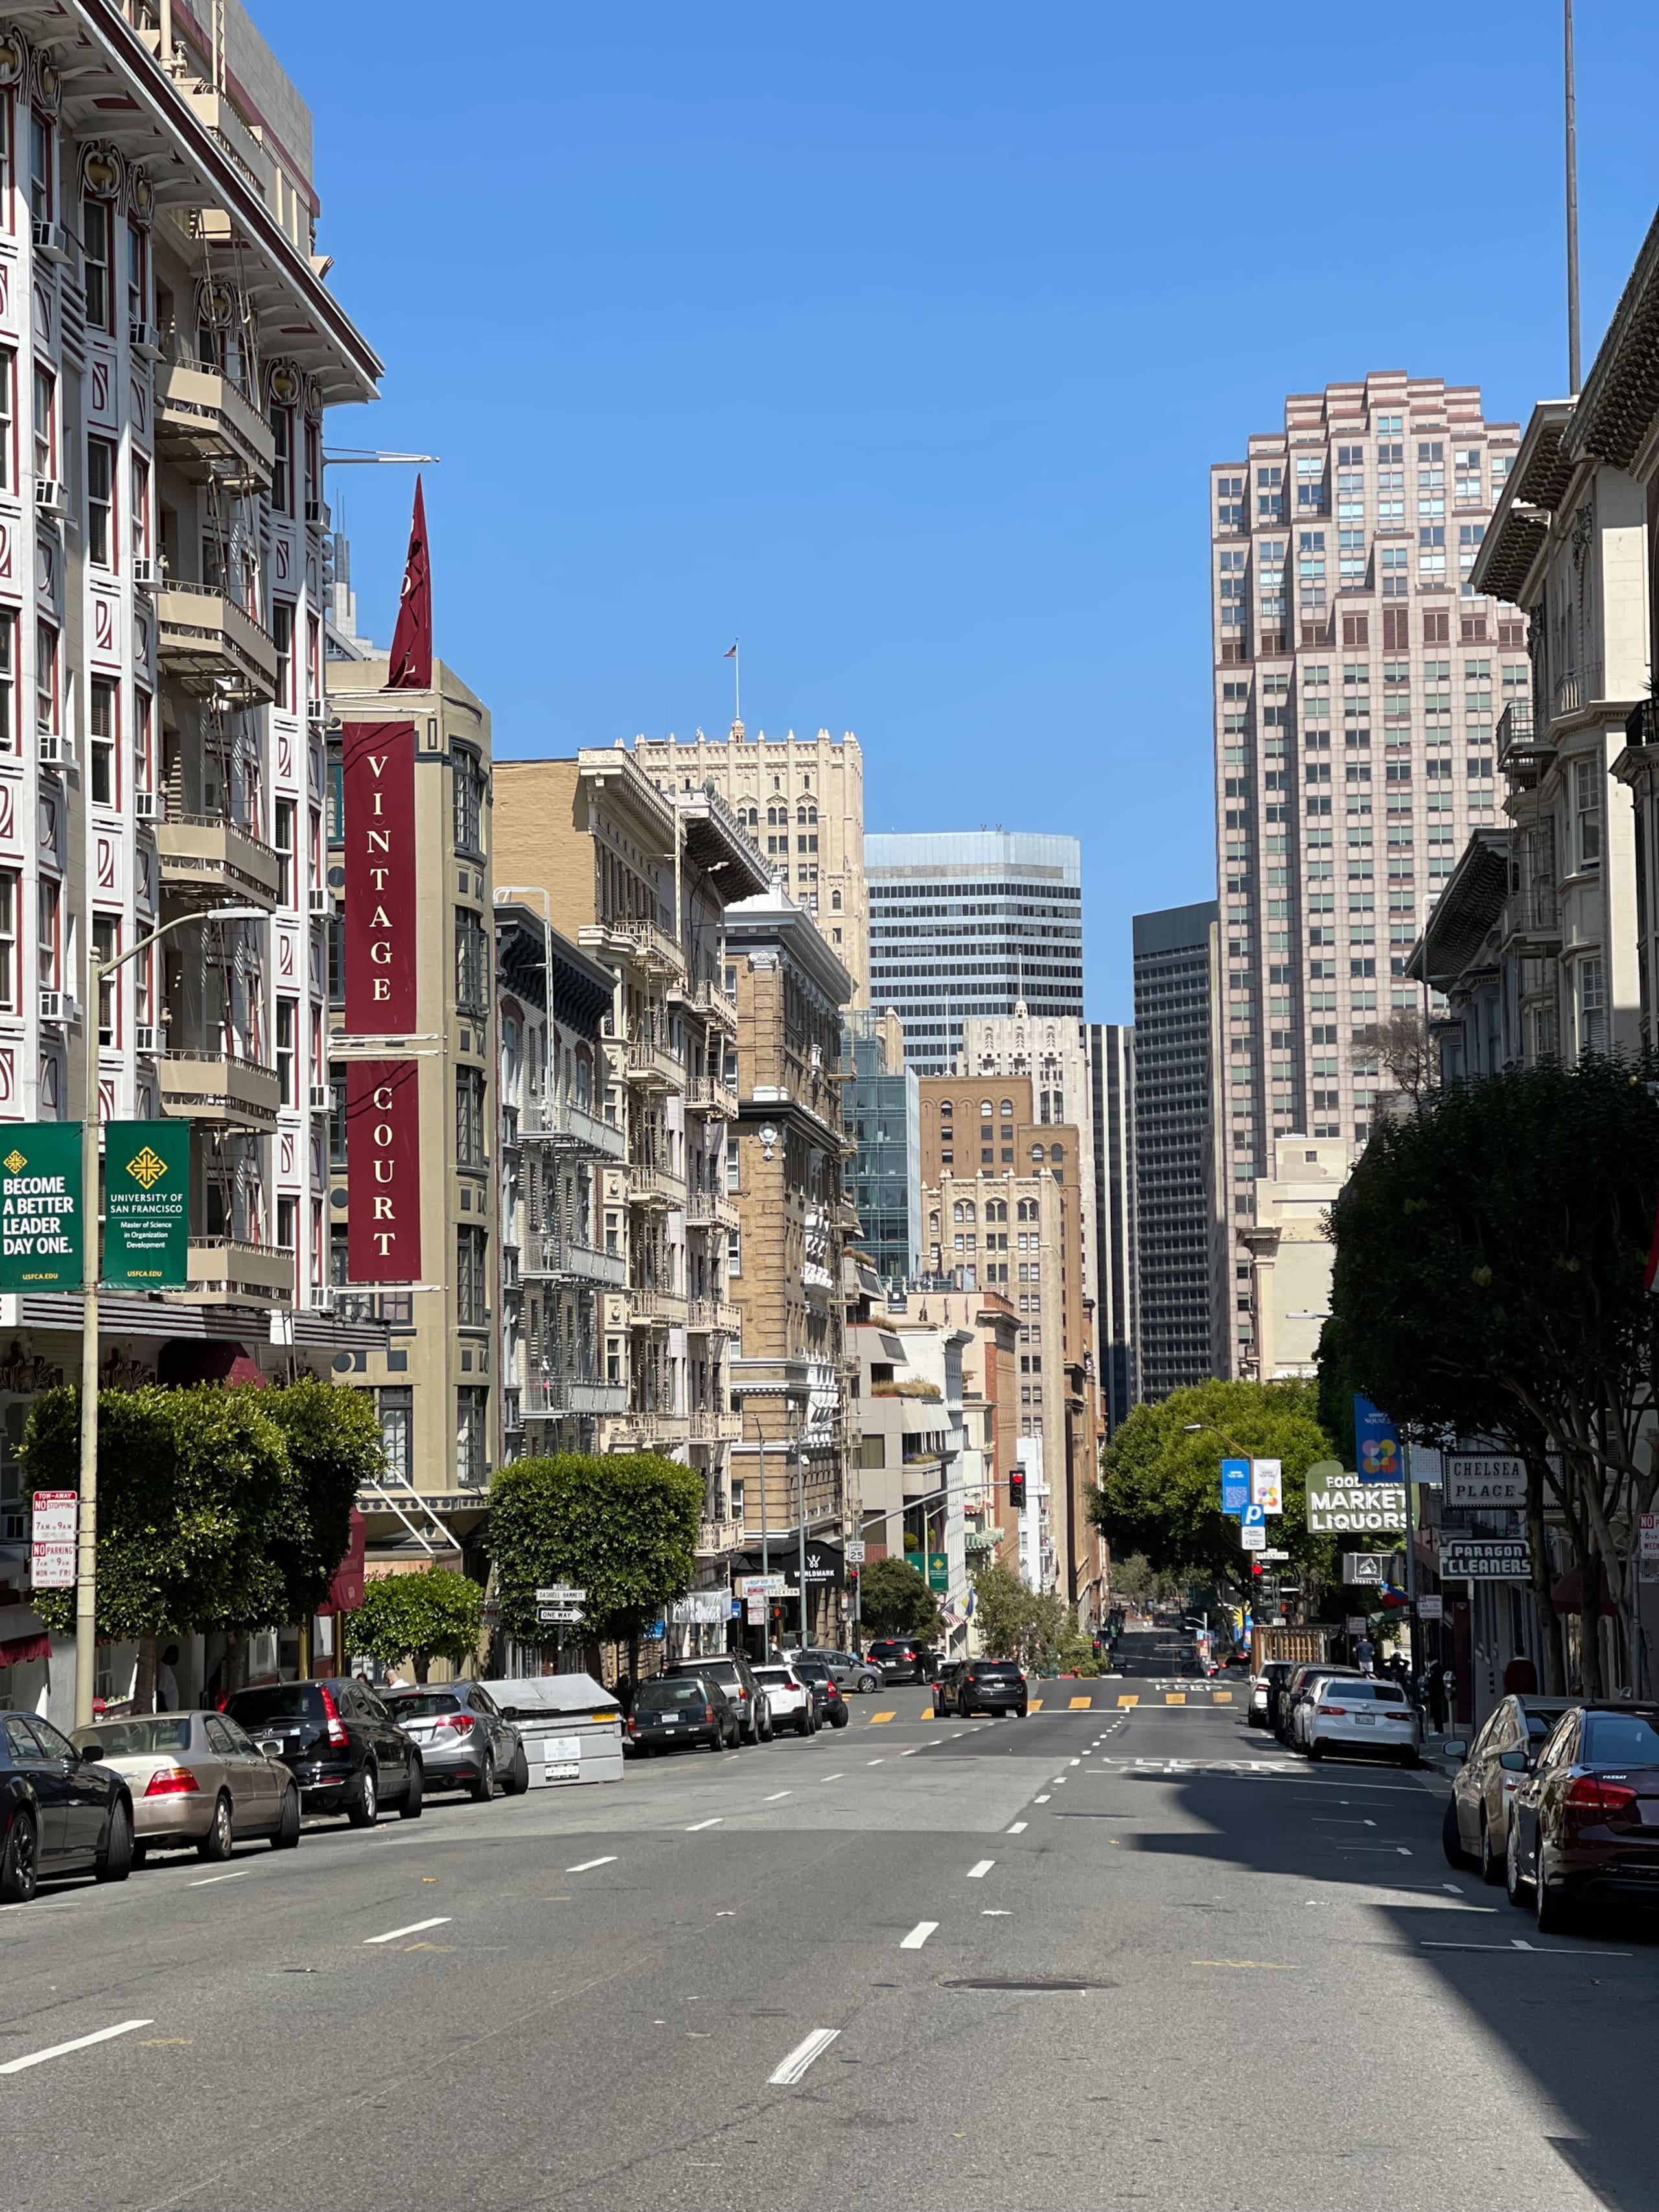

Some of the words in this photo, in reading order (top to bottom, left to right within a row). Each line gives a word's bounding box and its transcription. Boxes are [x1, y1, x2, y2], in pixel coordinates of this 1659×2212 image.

[366, 756, 392, 1001] VINTAGE
[373, 1086, 396, 1257] COURT
[3, 1176, 65, 1195] BECOME
[3, 1198, 14, 1215] A
[17, 1196, 74, 1215] BETTER
[132, 1205, 183, 1213] FRANCISCO
[3, 1217, 61, 1235] LEADER
[3, 1238, 34, 1255] DAY
[36, 1237, 73, 1254] ONE.
[1454, 1463, 1519, 1476] CHELSEA
[1456, 1485, 1514, 1496] PLACE
[35, 1501, 46, 1510] NO
[1311, 1490, 1406, 1510] MARKET
[1312, 1513, 1415, 1530] LIQUORS
[1641, 1517, 1653, 1528] NO
[34, 1544, 45, 1555] NO
[1456, 1546, 1522, 1557] PARAGON
[1448, 1559, 1531, 1573] CLEANERS
